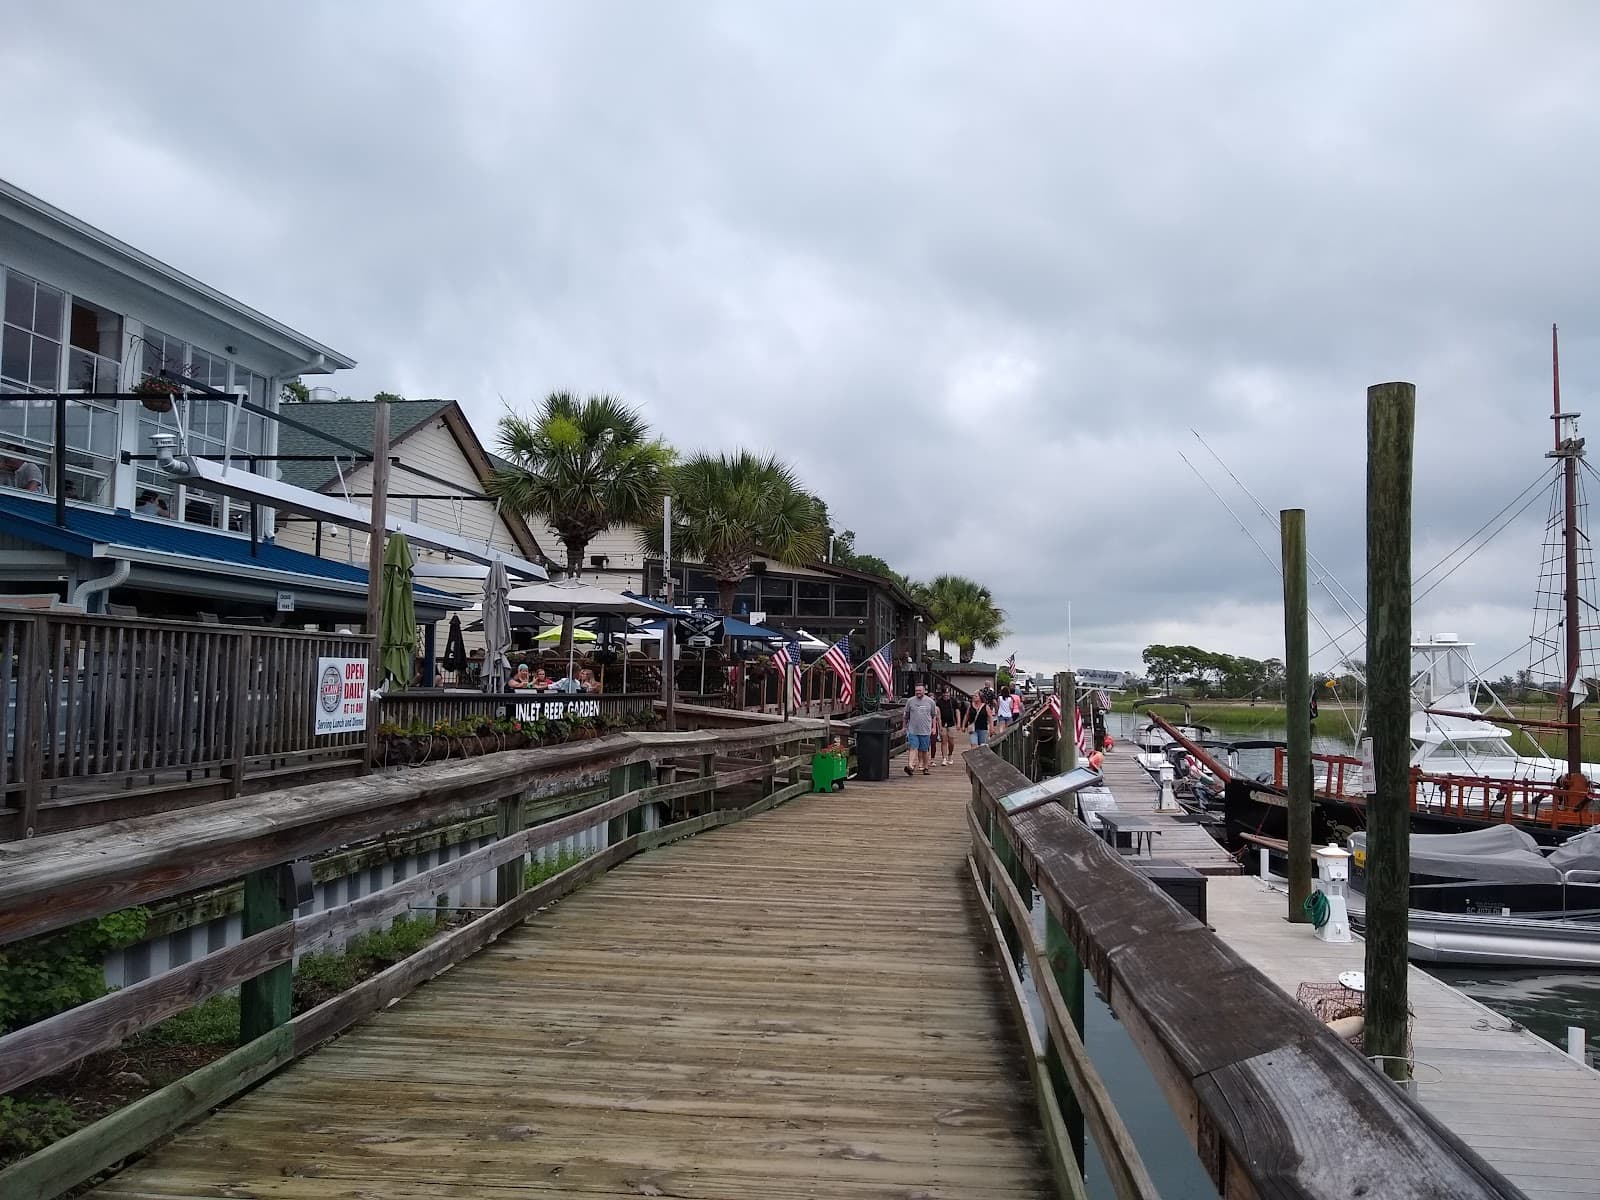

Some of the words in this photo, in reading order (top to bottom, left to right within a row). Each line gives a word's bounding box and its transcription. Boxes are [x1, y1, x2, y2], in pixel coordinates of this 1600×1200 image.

[345, 663, 365, 680] OPEN
[344, 683, 365, 699] DAILY
[343, 704, 349, 714] AT
[350, 704, 355, 714] 11
[355, 703, 364, 714] AM
[515, 702, 541, 722] INLET
[544, 701, 564, 720] BEER
[567, 700, 600, 718] GARDEN
[317, 719, 333, 731] Serving
[333, 717, 344, 729] Lunch
